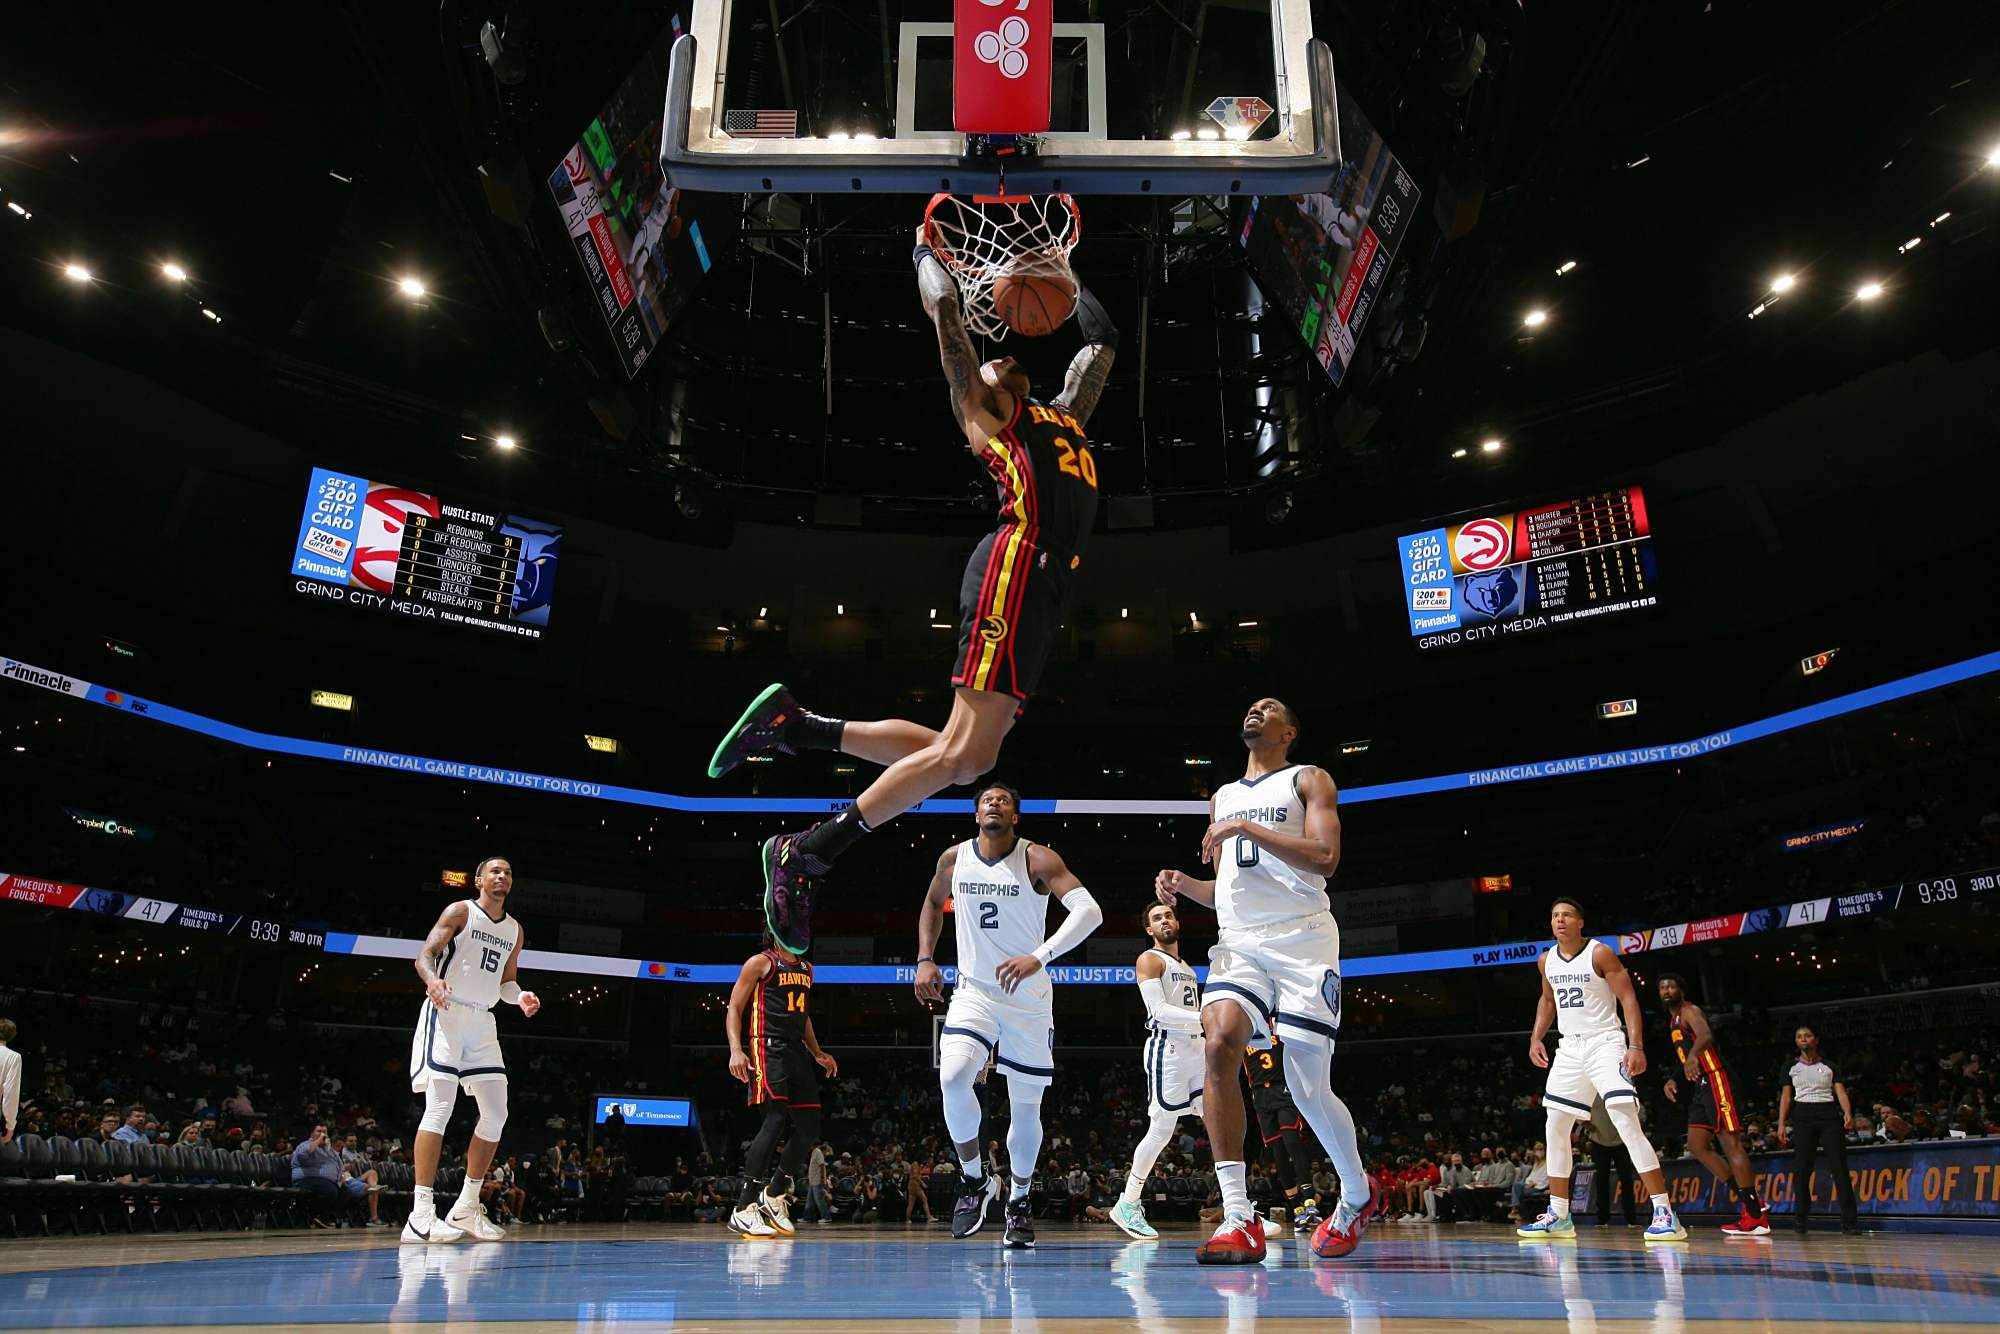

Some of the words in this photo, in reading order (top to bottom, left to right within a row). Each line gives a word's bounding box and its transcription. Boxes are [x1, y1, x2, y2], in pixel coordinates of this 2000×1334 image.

[1246, 103, 1259, 118] 75
[581, 186, 599, 216] 39
[1377, 194, 1400, 235] 9:39
[1327, 316, 1343, 341] 39
[1054, 437, 1097, 490] 20
[327, 478, 348, 489] GET
[348, 482, 356, 491] A
[318, 484, 357, 505] $200
[318, 500, 355, 517] GIFT
[441, 504, 471, 520] HUSTLE
[471, 511, 495, 526] STATS
[311, 512, 354, 530] CARD
[312, 530, 334, 545] $200
[415, 516, 427, 527] 30
[446, 523, 484, 541] REBOUNDS
[504, 537, 513, 547] 31
[1537, 528, 1561, 539] OKAFOR
[308, 539, 324, 550] GIFT
[324, 546, 344, 557] CARD
[416, 528, 422, 538] 3
[434, 532, 448, 544] OFF
[450, 536, 492, 554] REBOUNDS
[504, 549, 509, 558] 7
[1411, 537, 1429, 547] GET
[1430, 536, 1437, 544] A
[414, 540, 420, 550] 9
[444, 547, 478, 562] ASSISTS
[501, 560, 508, 569] 11
[1408, 544, 1441, 560] $200
[1532, 550, 1540, 558] 20
[1540, 545, 1565, 556] COLLINS
[298, 558, 347, 579] Pinnacle
[411, 551, 419, 561] 11
[436, 557, 482, 575] TURNOVERS
[1412, 557, 1442, 572] GIFT
[1543, 561, 1567, 572] MELTON
[441, 570, 473, 585] BLOCKS
[499, 582, 504, 592] 7
[1410, 568, 1447, 585] CARD
[1545, 570, 1570, 581] TILLMAN
[1546, 578, 1569, 590] CLARKE
[407, 575, 414, 585] 4
[440, 582, 469, 596] STEALS
[1416, 590, 1435, 599] $200
[1547, 588, 1567, 599] JONES
[295, 580, 344, 600] GRIND
[349, 591, 386, 608] CITY
[390, 599, 436, 619] MEDIA
[405, 587, 411, 596] 4
[421, 589, 467, 608] FASTBREAK
[467, 599, 483, 611] PTS
[494, 605, 500, 614] 6
[1541, 601, 1549, 609] 22
[1549, 596, 1566, 607] BANE
[1551, 612, 1574, 623] FOLLOW
[1574, 601, 1631, 619] @GRINDCITYMEDIA
[440, 611, 464, 623] FOLLOW
[464, 616, 517, 633] @GRINDCITYMEDIA
[1414, 613, 1457, 630] Pinnacle
[1419, 632, 1461, 649] GRIND
[1465, 624, 1498, 641] CITY
[1502, 616, 1547, 635] MEDIA
[3, 660, 72, 693] Pinnacle
[1468, 765, 1542, 786] FINANCIAL
[1544, 759, 1586, 775] GAME
[1589, 752, 1626, 769] PLAN
[1629, 748, 1666, 764] JUST
[1670, 743, 1700, 758] FOR
[1701, 733, 1731, 751] YOU
[343, 748, 421, 771] FINANCIAL
[424, 760, 465, 778] GAME
[469, 766, 504, 783] PLAN
[507, 772, 541, 788] JUST
[543, 778, 569, 792] FOR
[572, 782, 601, 797] YOU
[1219, 806, 1288, 823] MPHIS
[1786, 835, 1810, 847] GRIND
[1810, 831, 1830, 842] CITY
[1236, 835, 1259, 868] 0
[12, 877, 55, 894] TIMEOUTS:
[56, 885, 62, 895] 5
[959, 881, 1020, 897] MEMPHIS
[1918, 878, 1958, 904] 9:39
[1970, 876, 1995, 891] 3RD
[8, 888, 37, 903] FOULS:
[38, 893, 45, 903] 0
[1837, 893, 1877, 908] TIMEOUTS:
[1877, 890, 1884, 901] 5
[141, 901, 162, 921] 47
[182, 907, 217, 922] TIMEOUTS:
[217, 913, 223, 923] 5
[979, 901, 999, 929] 2
[1800, 902, 1816, 922] 47
[1839, 905, 1864, 917] FOULS:
[1864, 904, 1871, 913] 0
[179, 917, 203, 929] FOULS:
[203, 920, 209, 930] 0
[250, 920, 280, 943] 9:39
[1691, 919, 1724, 933] TIMEOUTS:
[1724, 918, 1729, 927] 5
[288, 929, 306, 945] 3RD
[306, 933, 323, 947] QTR
[471, 929, 514, 952] MEMPHIS
[1660, 927, 1678, 946] 39
[1692, 931, 1713, 942] FOULS:
[1714, 929, 1719, 938] 0
[480, 946, 501, 974] 15
[1473, 951, 1500, 965] PLAY
[1503, 945, 1537, 960] HARD
[1051, 968, 1069, 982] AN
[1073, 968, 1111, 982] JUST
[1116, 968, 1138, 982] FO
[1549, 972, 1591, 984] MEMPHIS
[787, 991, 805, 1013] 14
[1183, 985, 1198, 1008] 21
[1556, 987, 1584, 1009] 22
[1259, 1053, 1273, 1070] 3
[645, 1112, 682, 1120] Tennessee
[1922, 1166, 1961, 1202] OF
